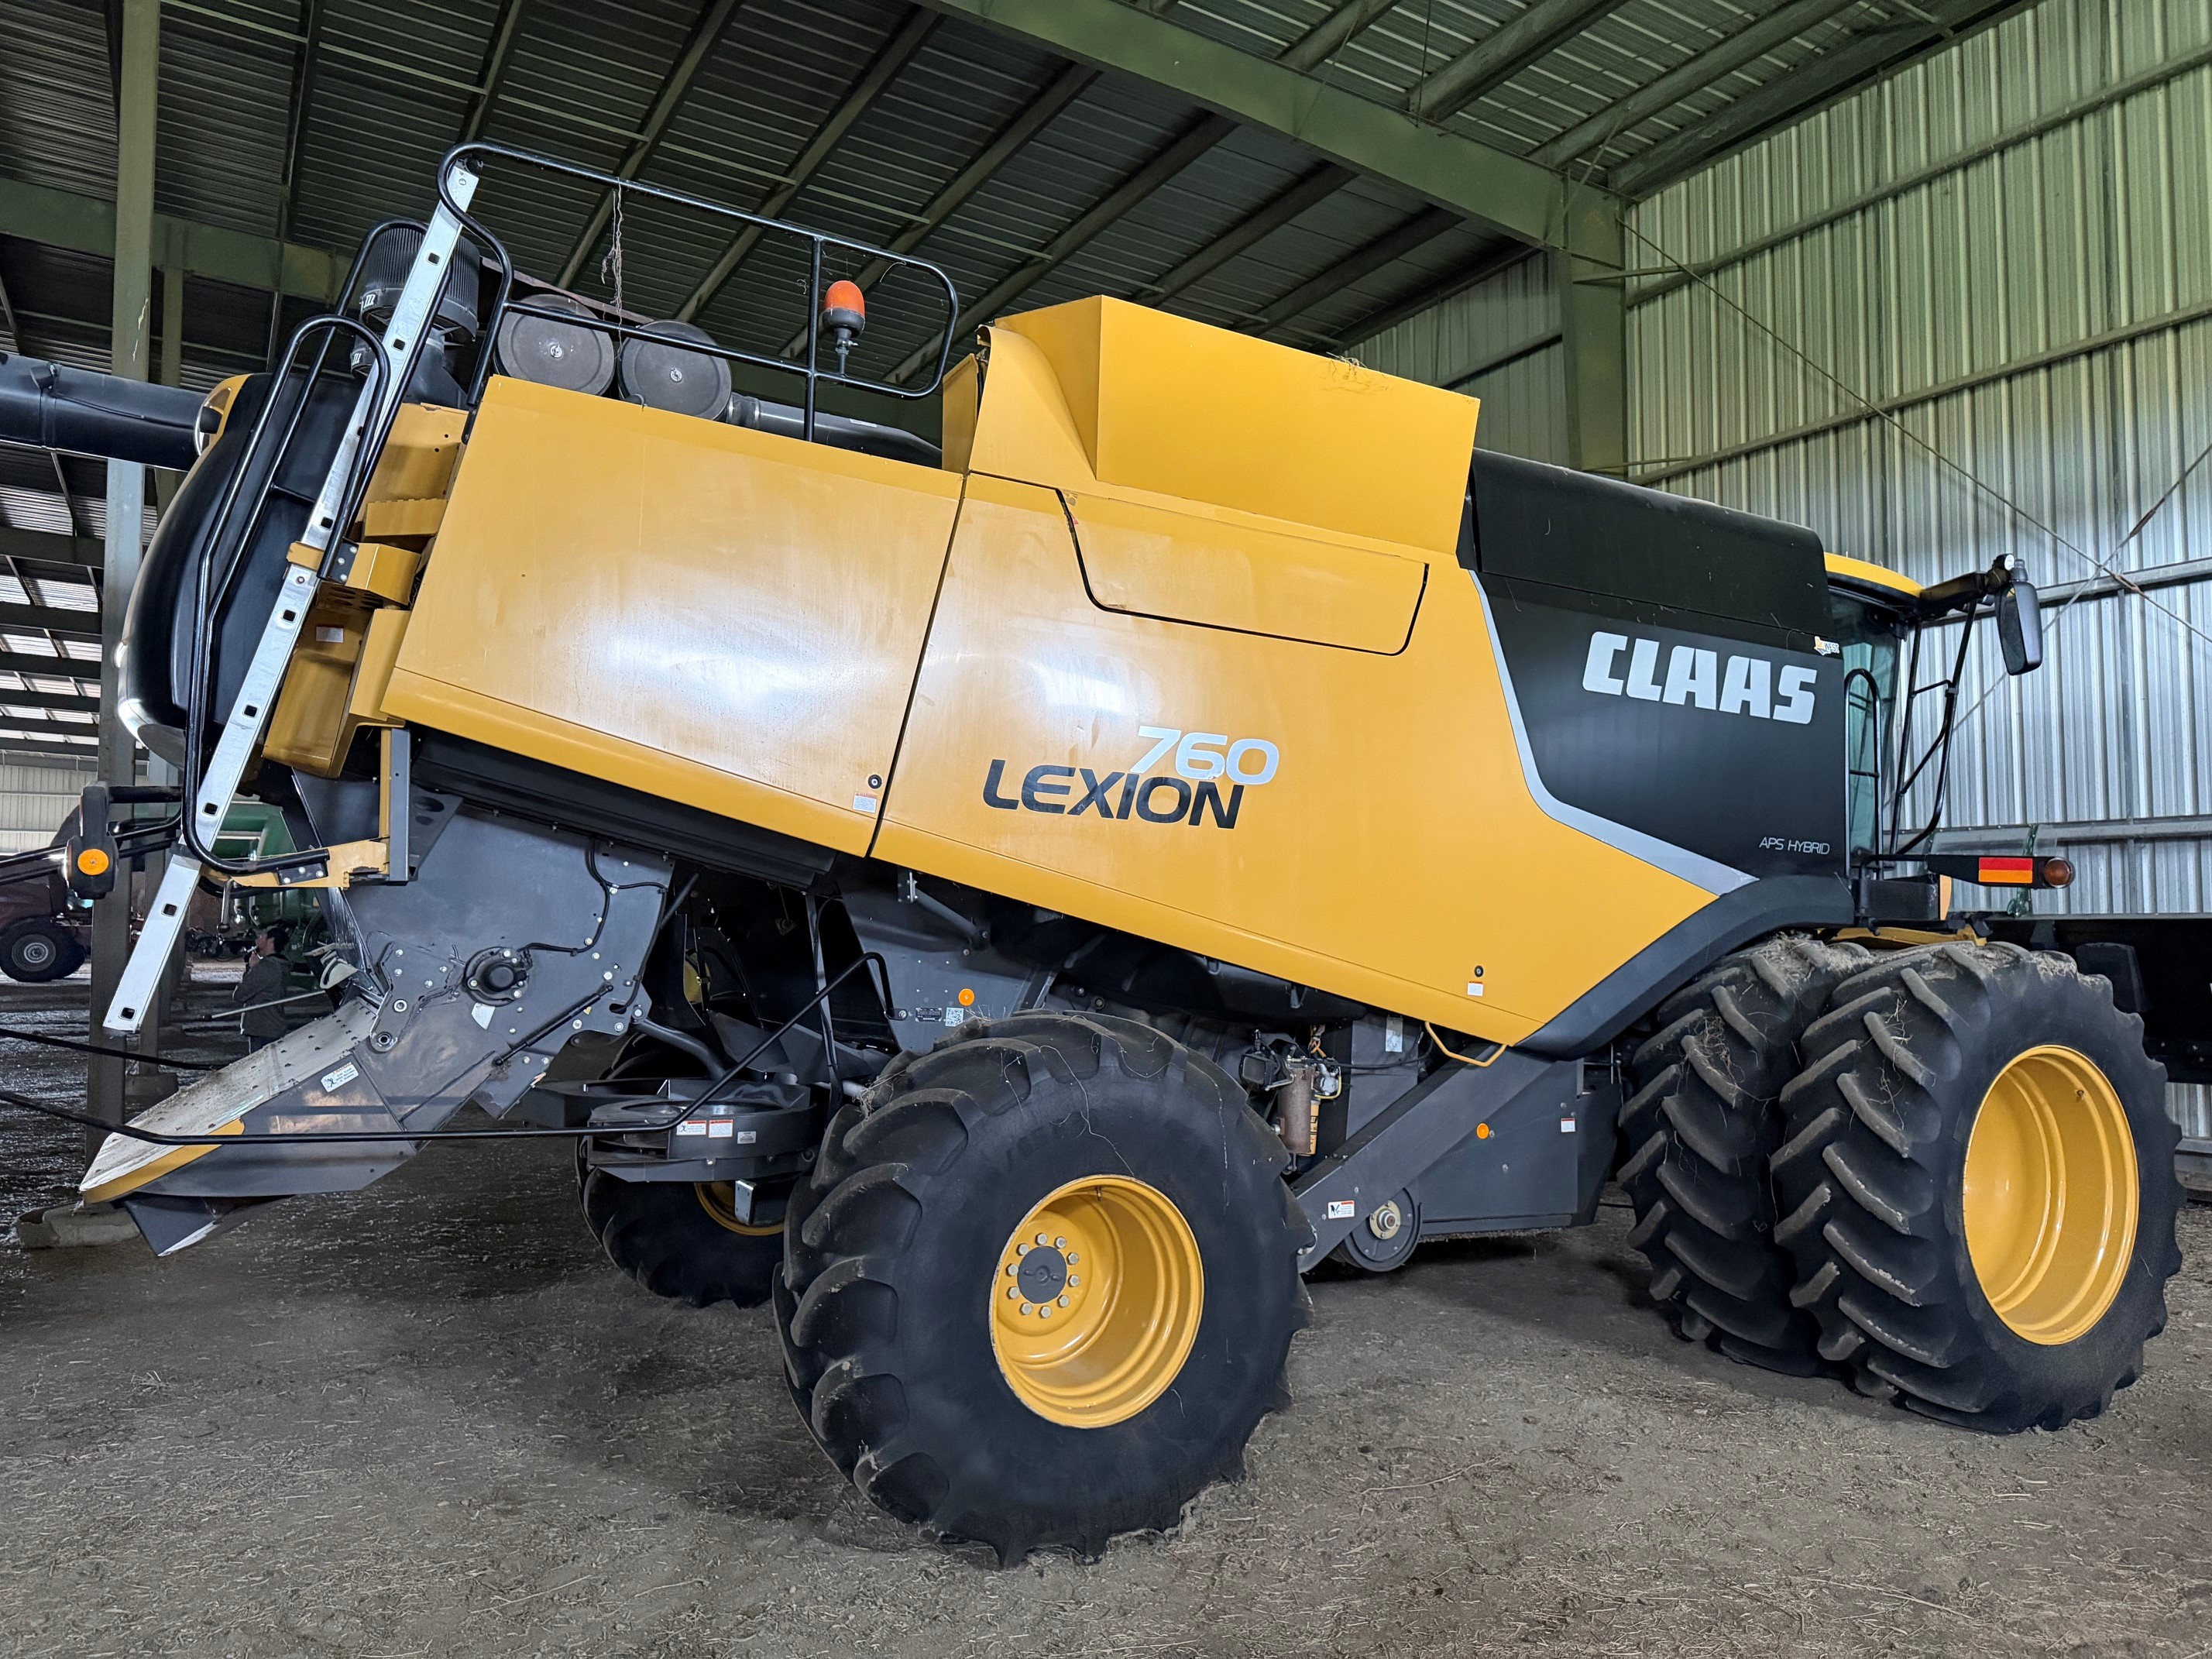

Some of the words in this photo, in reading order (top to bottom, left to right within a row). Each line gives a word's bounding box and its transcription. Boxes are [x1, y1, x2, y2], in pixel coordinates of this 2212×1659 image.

[1582, 631, 1817, 724] CLAAS
[1129, 725, 1279, 785] 760
[982, 758, 1245, 830] LEXION
[1759, 836, 1784, 850] APS
[1788, 840, 1830, 855] HYBRID
